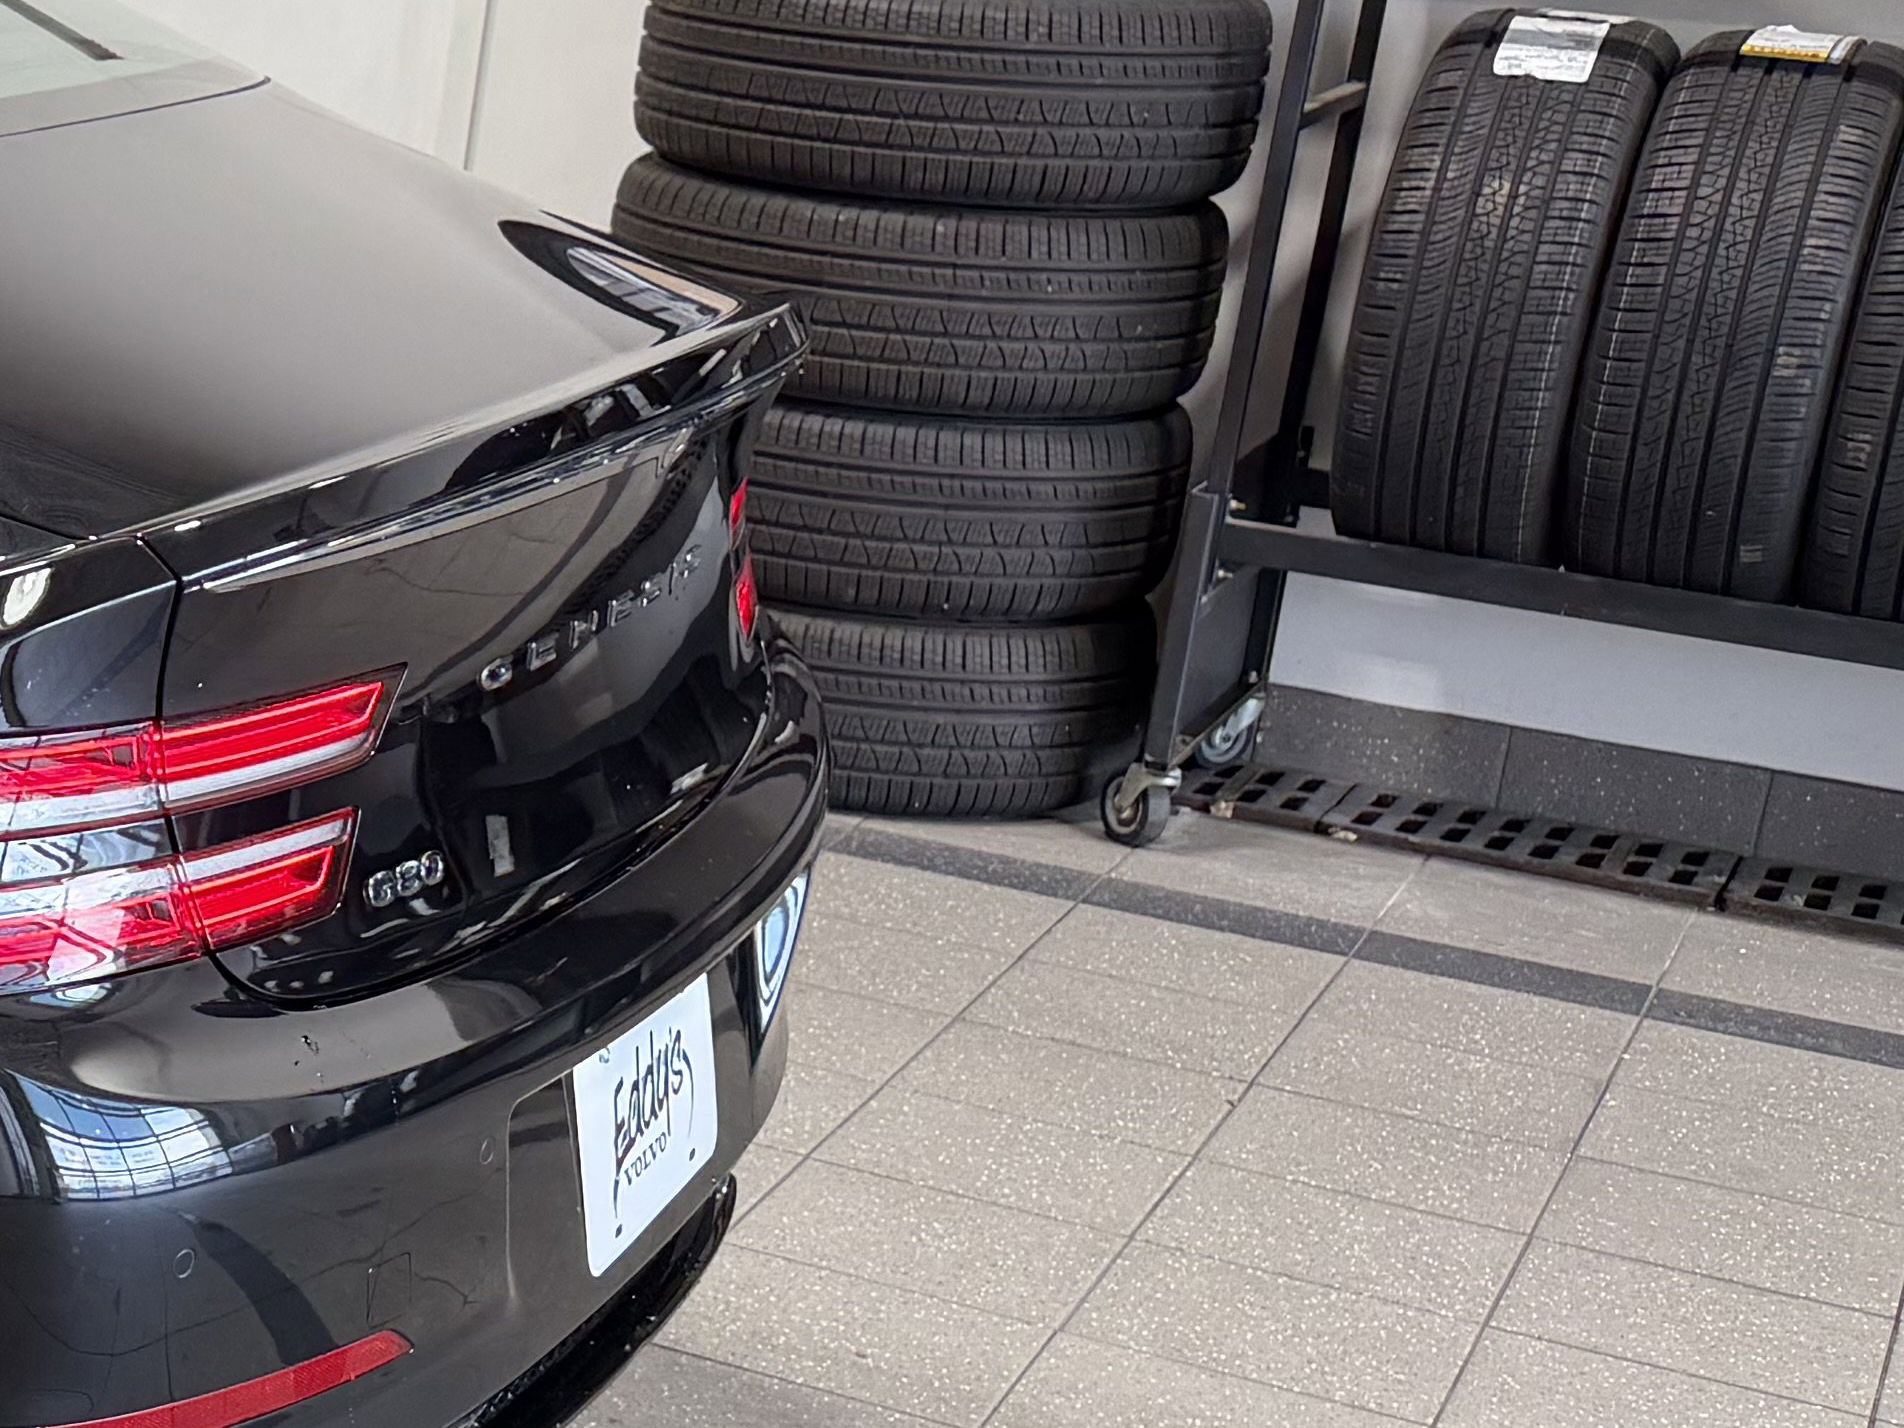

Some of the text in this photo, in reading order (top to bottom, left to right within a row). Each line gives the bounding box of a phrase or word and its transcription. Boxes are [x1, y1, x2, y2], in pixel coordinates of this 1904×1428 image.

[477, 543, 703, 692] GENESIS
[363, 850, 444, 908] G80
[613, 1026, 684, 1178] Eddy's
[623, 1131, 668, 1186] VOLVO
